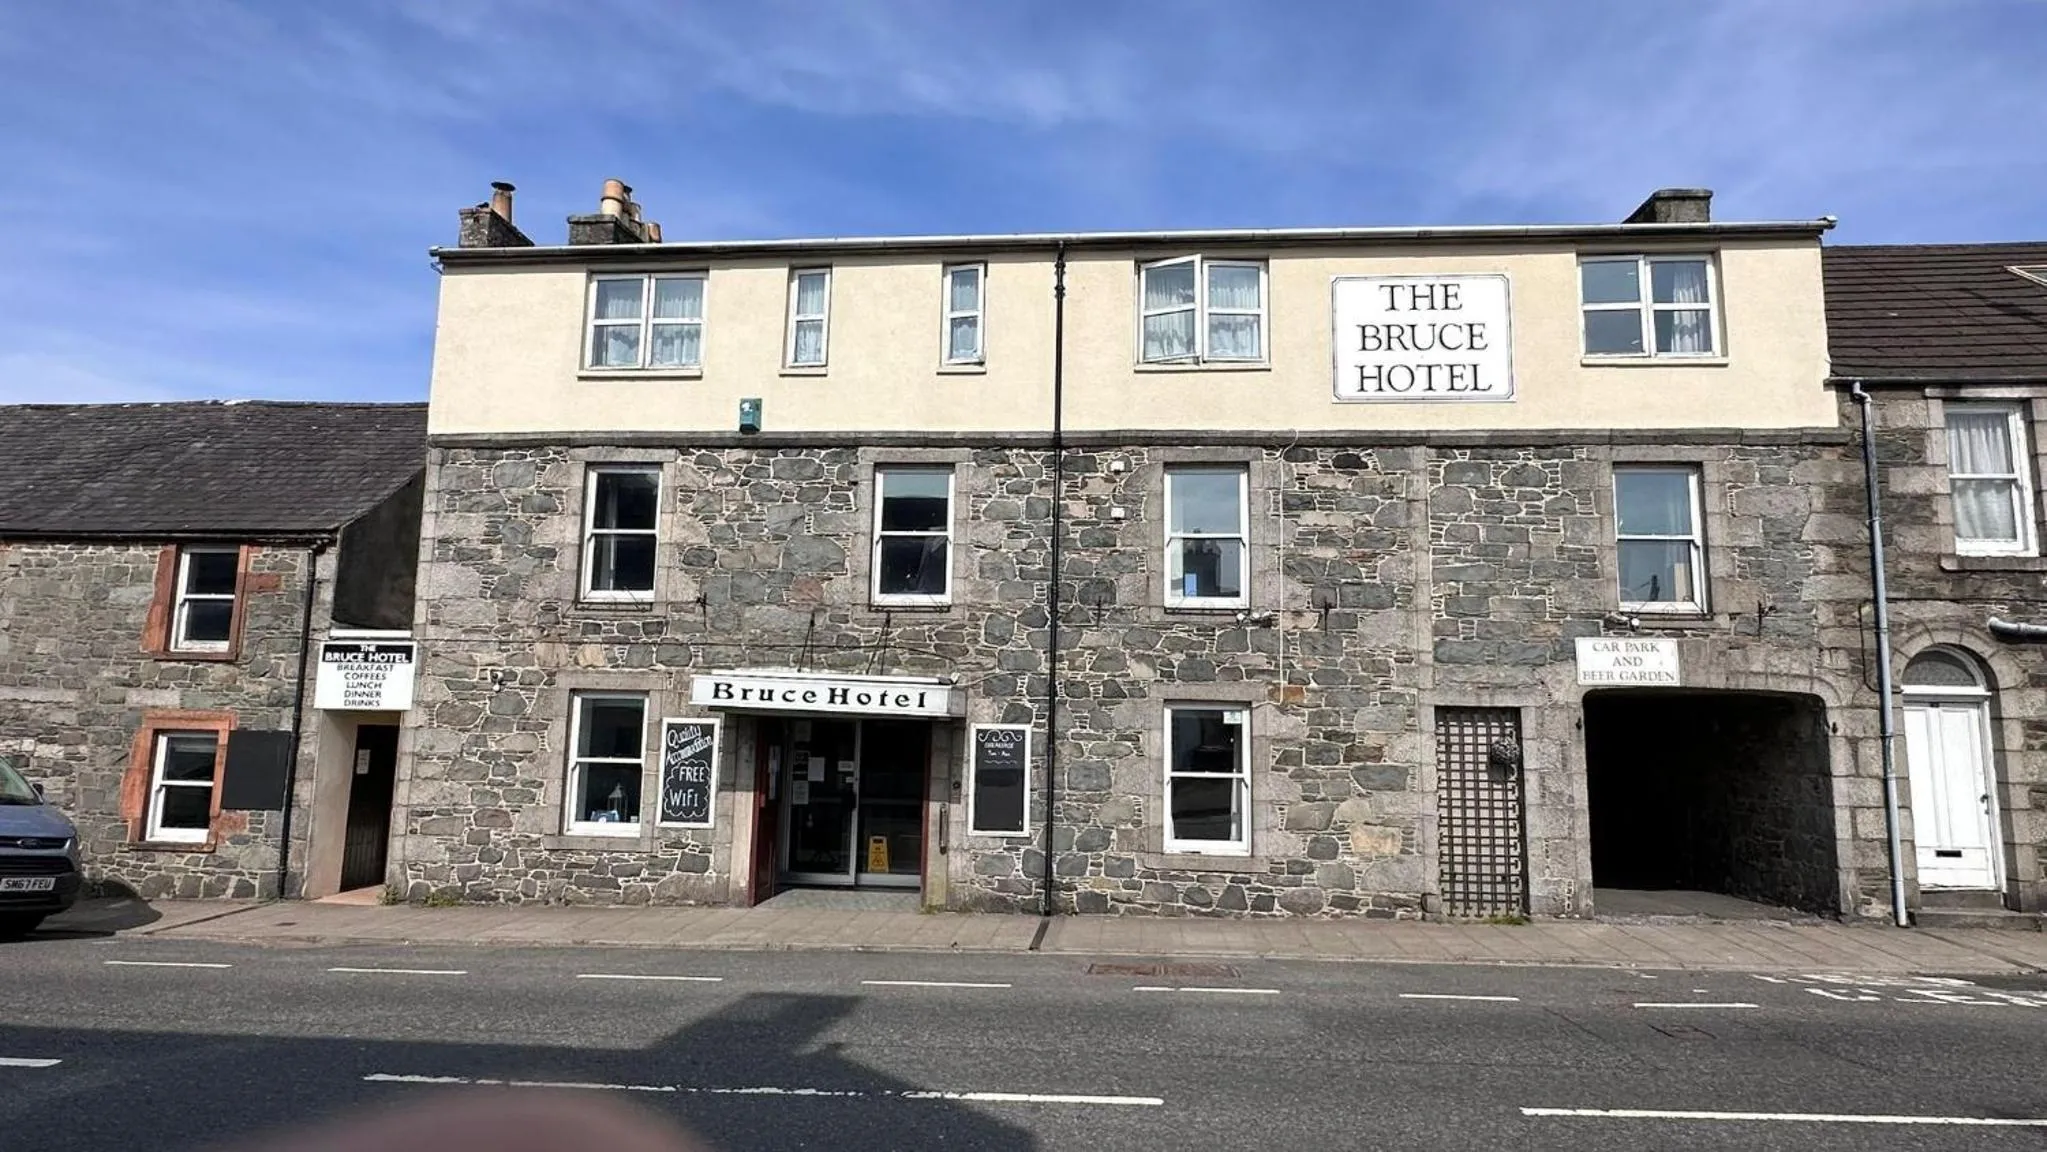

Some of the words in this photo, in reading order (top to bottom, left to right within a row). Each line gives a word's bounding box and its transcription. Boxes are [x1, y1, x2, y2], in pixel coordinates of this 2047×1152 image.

[1379, 283, 1463, 311] THE
[1356, 323, 1488, 351] BRUCE
[1354, 363, 1493, 392] HOTEL
[360, 644, 377, 652] THE
[1592, 642, 1621, 653] CAR
[1625, 642, 1661, 653] PARK
[325, 652, 365, 662] BRUCE
[368, 653, 409, 663] HOTEL
[1612, 656, 1644, 667] AND
[336, 663, 394, 672] BREAKFAST
[343, 672, 387, 681] COFFEES
[1582, 670, 1616, 681] BEER
[1619, 670, 1676, 682] GARDEN
[346, 681, 382, 690] LUNCH
[343, 690, 382, 699] DINNER
[712, 682, 818, 703] Bruce
[827, 687, 927, 708] Hotel
[343, 699, 381, 708] DRINKS
[667, 725, 702, 749] Quality
[679, 766, 706, 783] FREE
[31, 879, 52, 889] FEU
